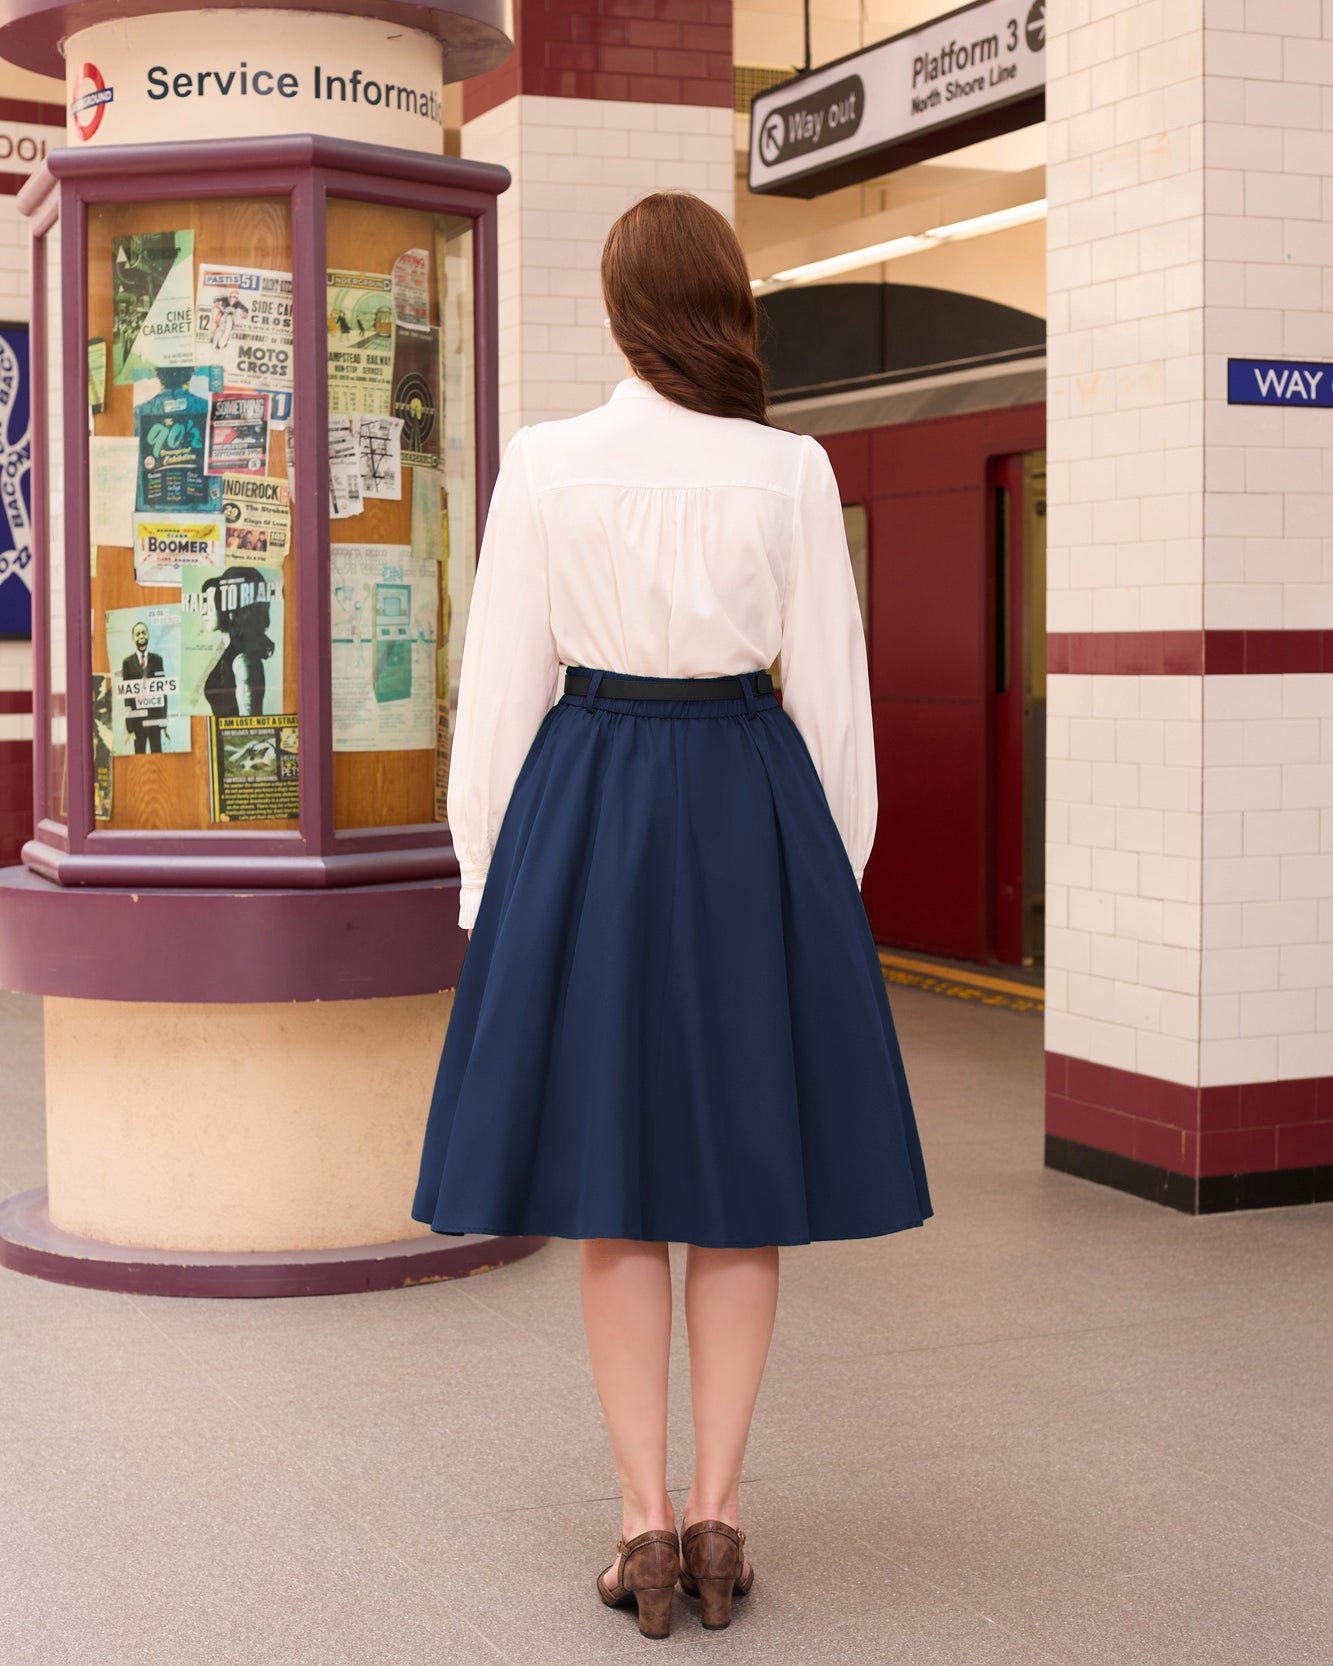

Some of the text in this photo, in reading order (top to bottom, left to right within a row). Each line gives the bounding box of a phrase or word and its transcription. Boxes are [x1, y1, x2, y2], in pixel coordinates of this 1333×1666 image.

[912, 18, 1018, 89] Platform 3
[147, 61, 299, 100] Service
[911, 64, 1016, 115] North Shore Line
[788, 93, 856, 143] Way out
[241, 274, 257, 289] 51
[166, 307, 192, 322] CINÉ
[251, 300, 274, 315] SIDE
[142, 321, 192, 336] CABARET
[199, 314, 210, 331] 12
[251, 315, 292, 328] CROS
[238, 345, 289, 363] MOTO
[237, 360, 288, 376] CROSS
[1254, 368, 1324, 400] WAY
[148, 537, 209, 554] BOOMER
[220, 584, 238, 612] TO
[137, 696, 162, 706] VOICE
